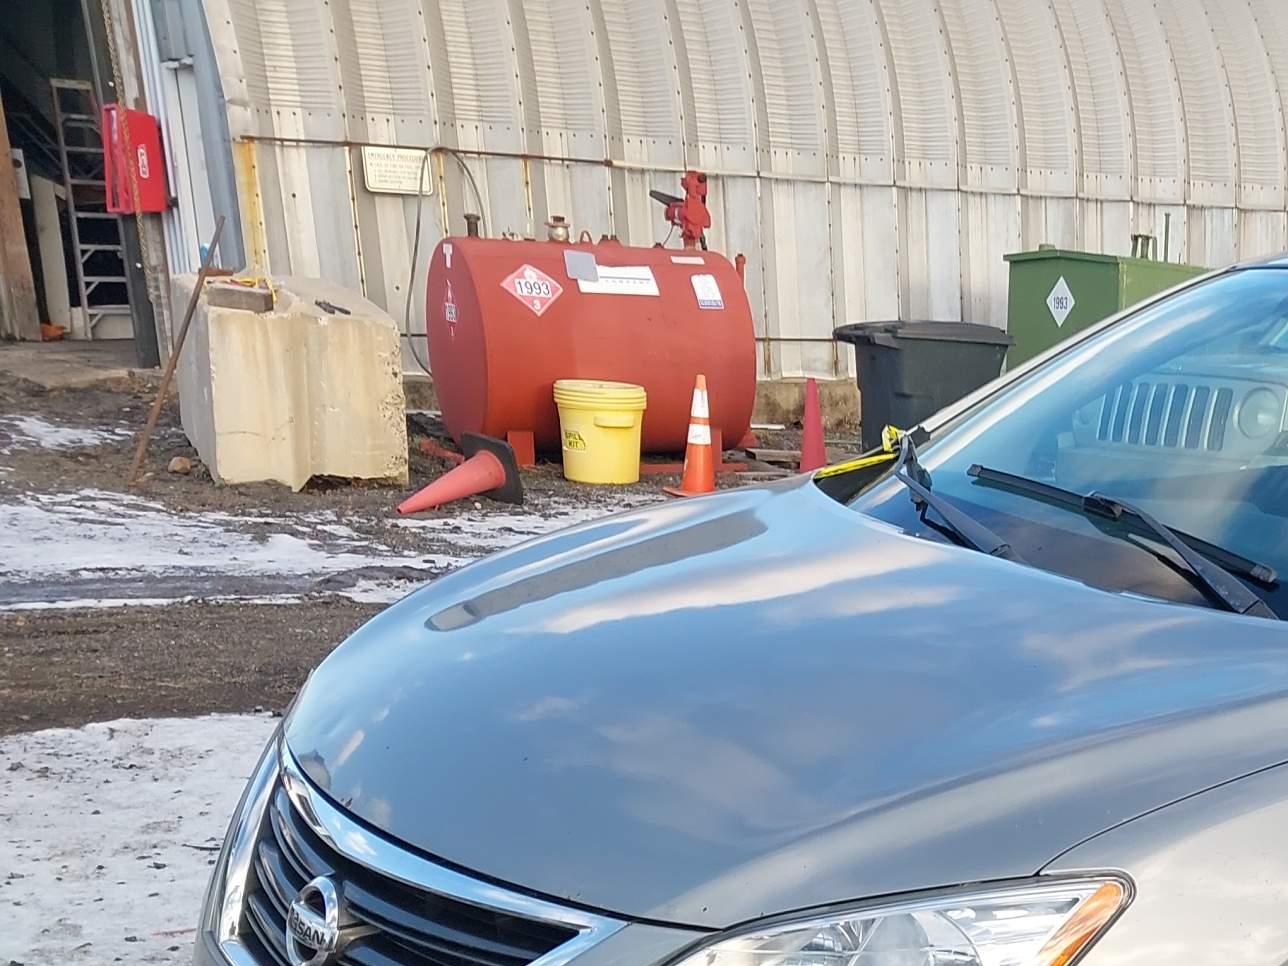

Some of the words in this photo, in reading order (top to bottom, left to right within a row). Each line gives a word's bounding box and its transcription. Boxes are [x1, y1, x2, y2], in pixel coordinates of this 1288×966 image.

[517, 280, 550, 296] 1993
[533, 299, 542, 311] 3
[1053, 296, 1068, 310] 1993
